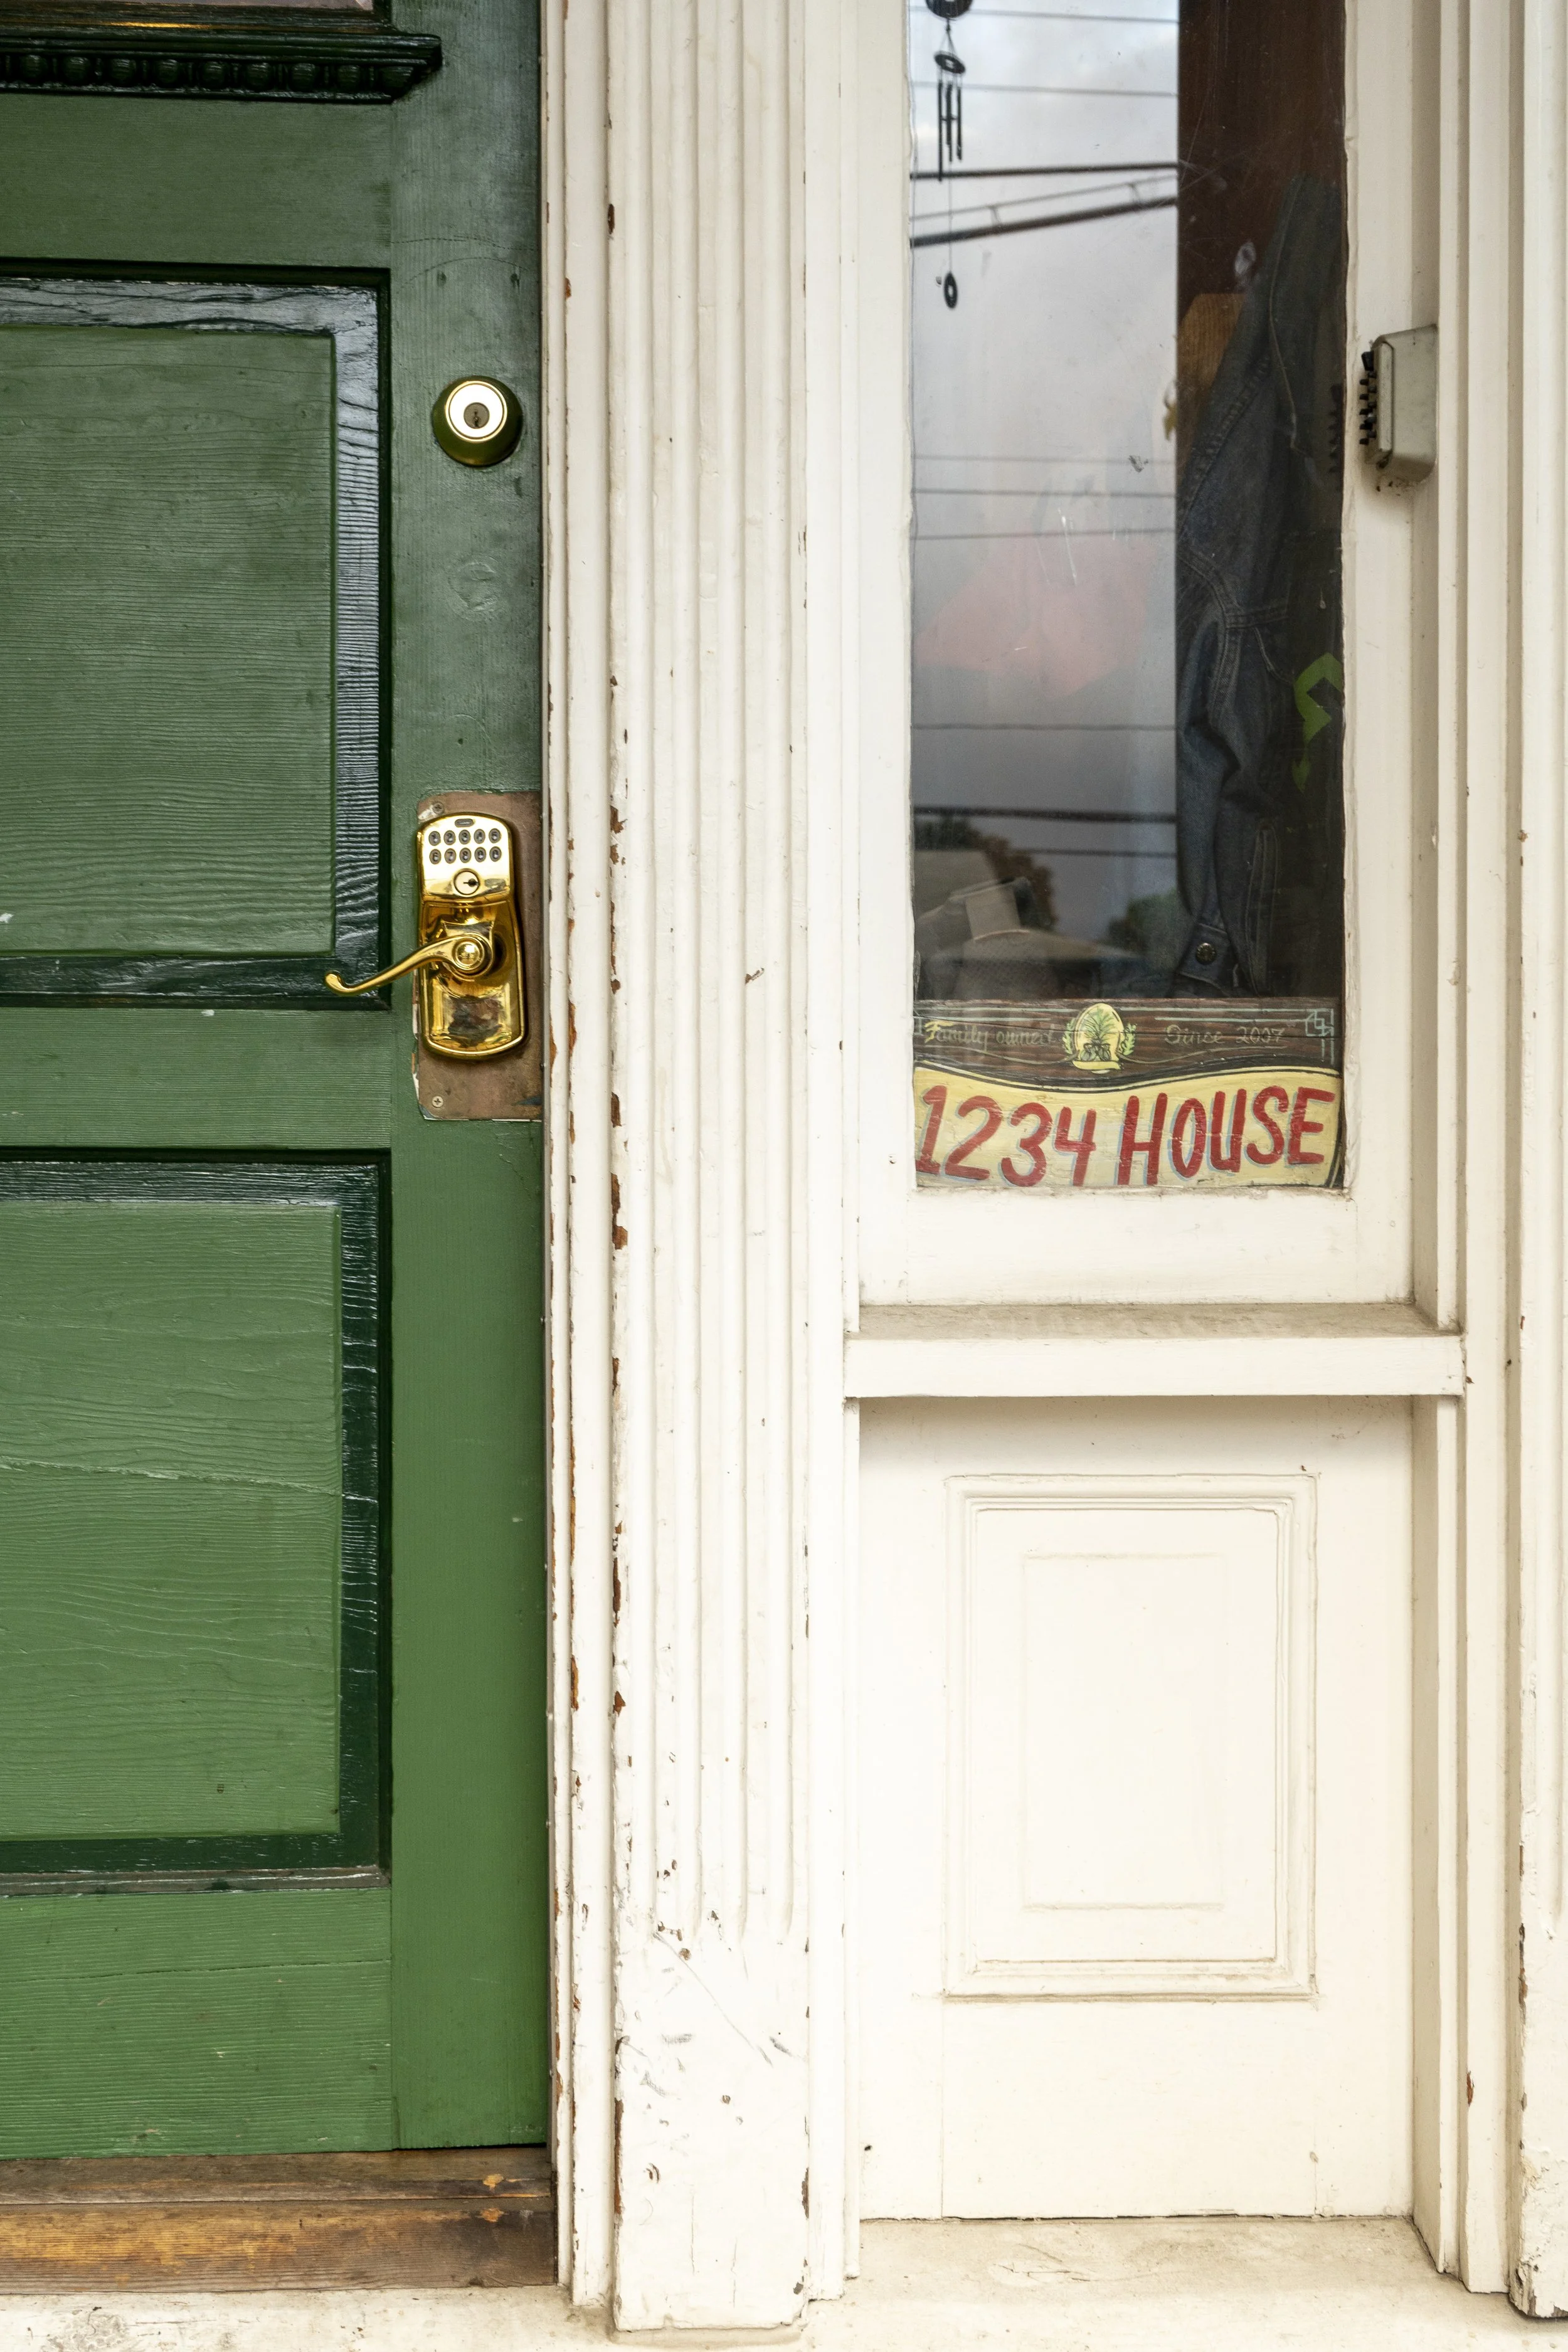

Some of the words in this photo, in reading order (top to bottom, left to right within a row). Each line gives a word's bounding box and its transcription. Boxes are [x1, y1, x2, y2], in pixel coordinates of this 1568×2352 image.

[924, 1020, 988, 1052] Family
[1164, 1024, 1226, 1044] Since
[1235, 1026, 1286, 1044] 2007
[915, 1084, 1097, 1187] 1234
[1117, 1085, 1336, 1186] HOUSE
